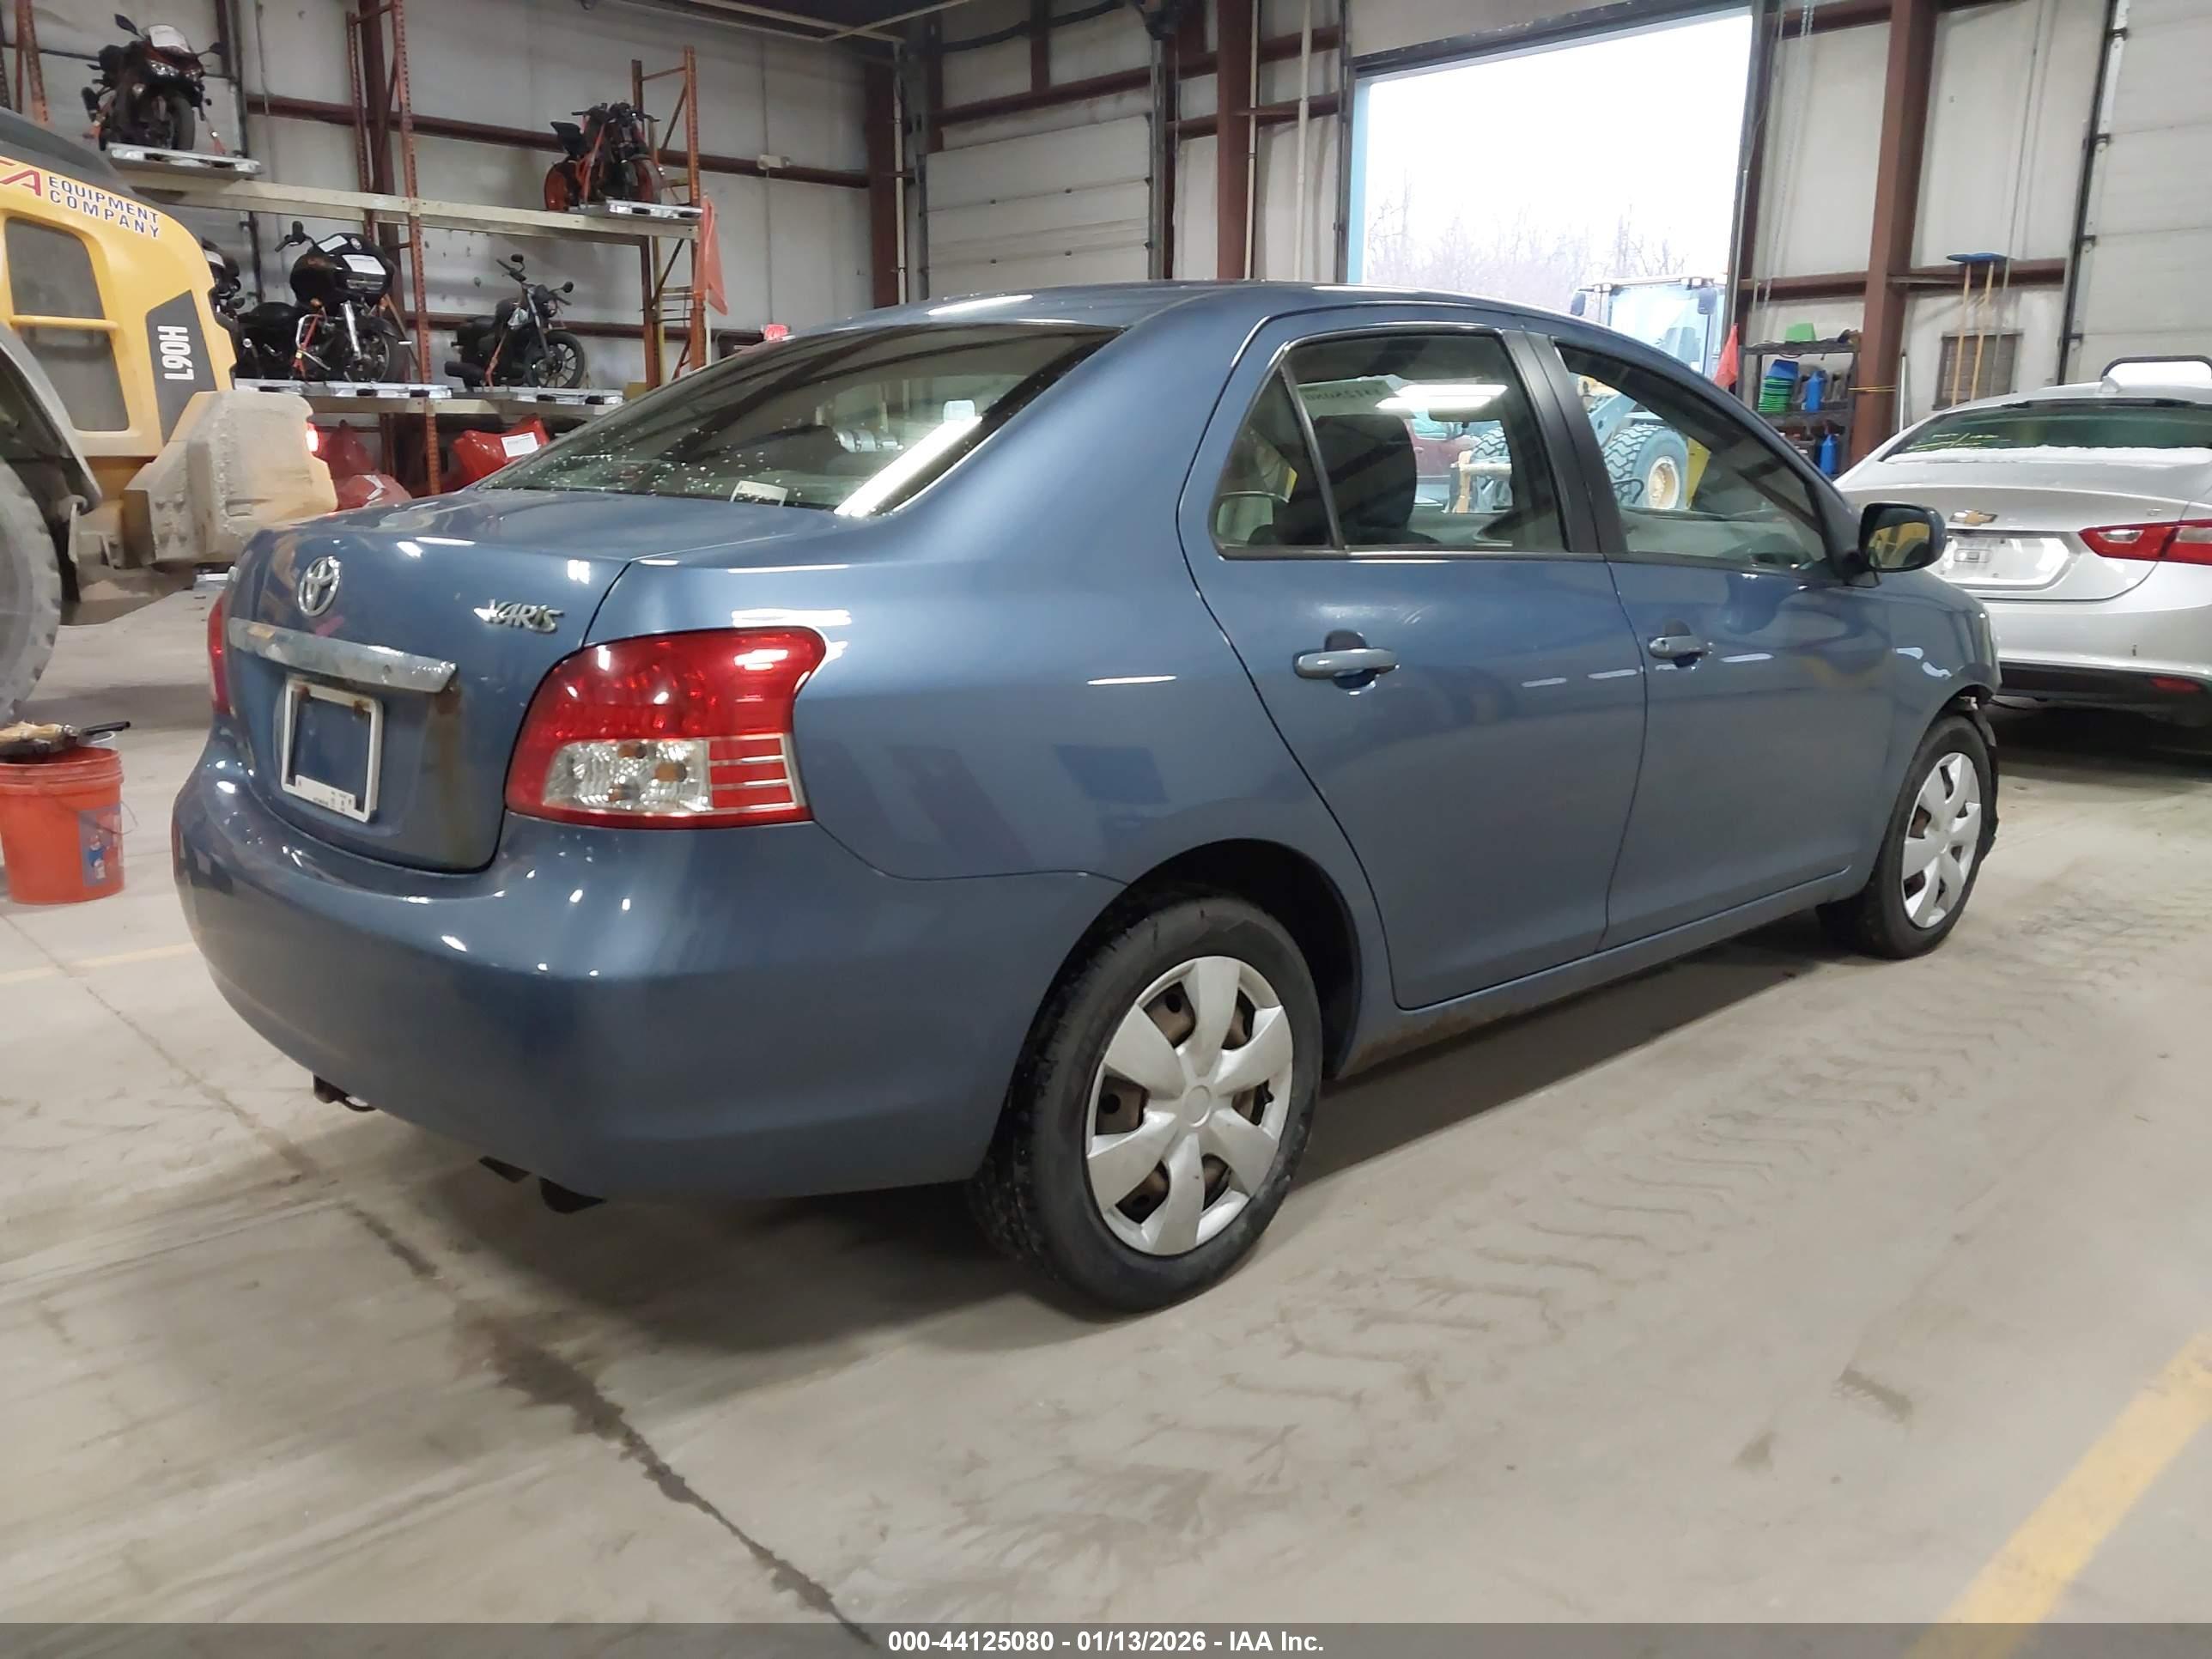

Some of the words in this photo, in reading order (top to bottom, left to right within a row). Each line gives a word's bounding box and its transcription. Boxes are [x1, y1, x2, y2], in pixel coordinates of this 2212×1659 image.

[49, 176, 158, 223] EQUIPMENT
[50, 190, 159, 238] COMPANY
[157, 325, 194, 380] H061
